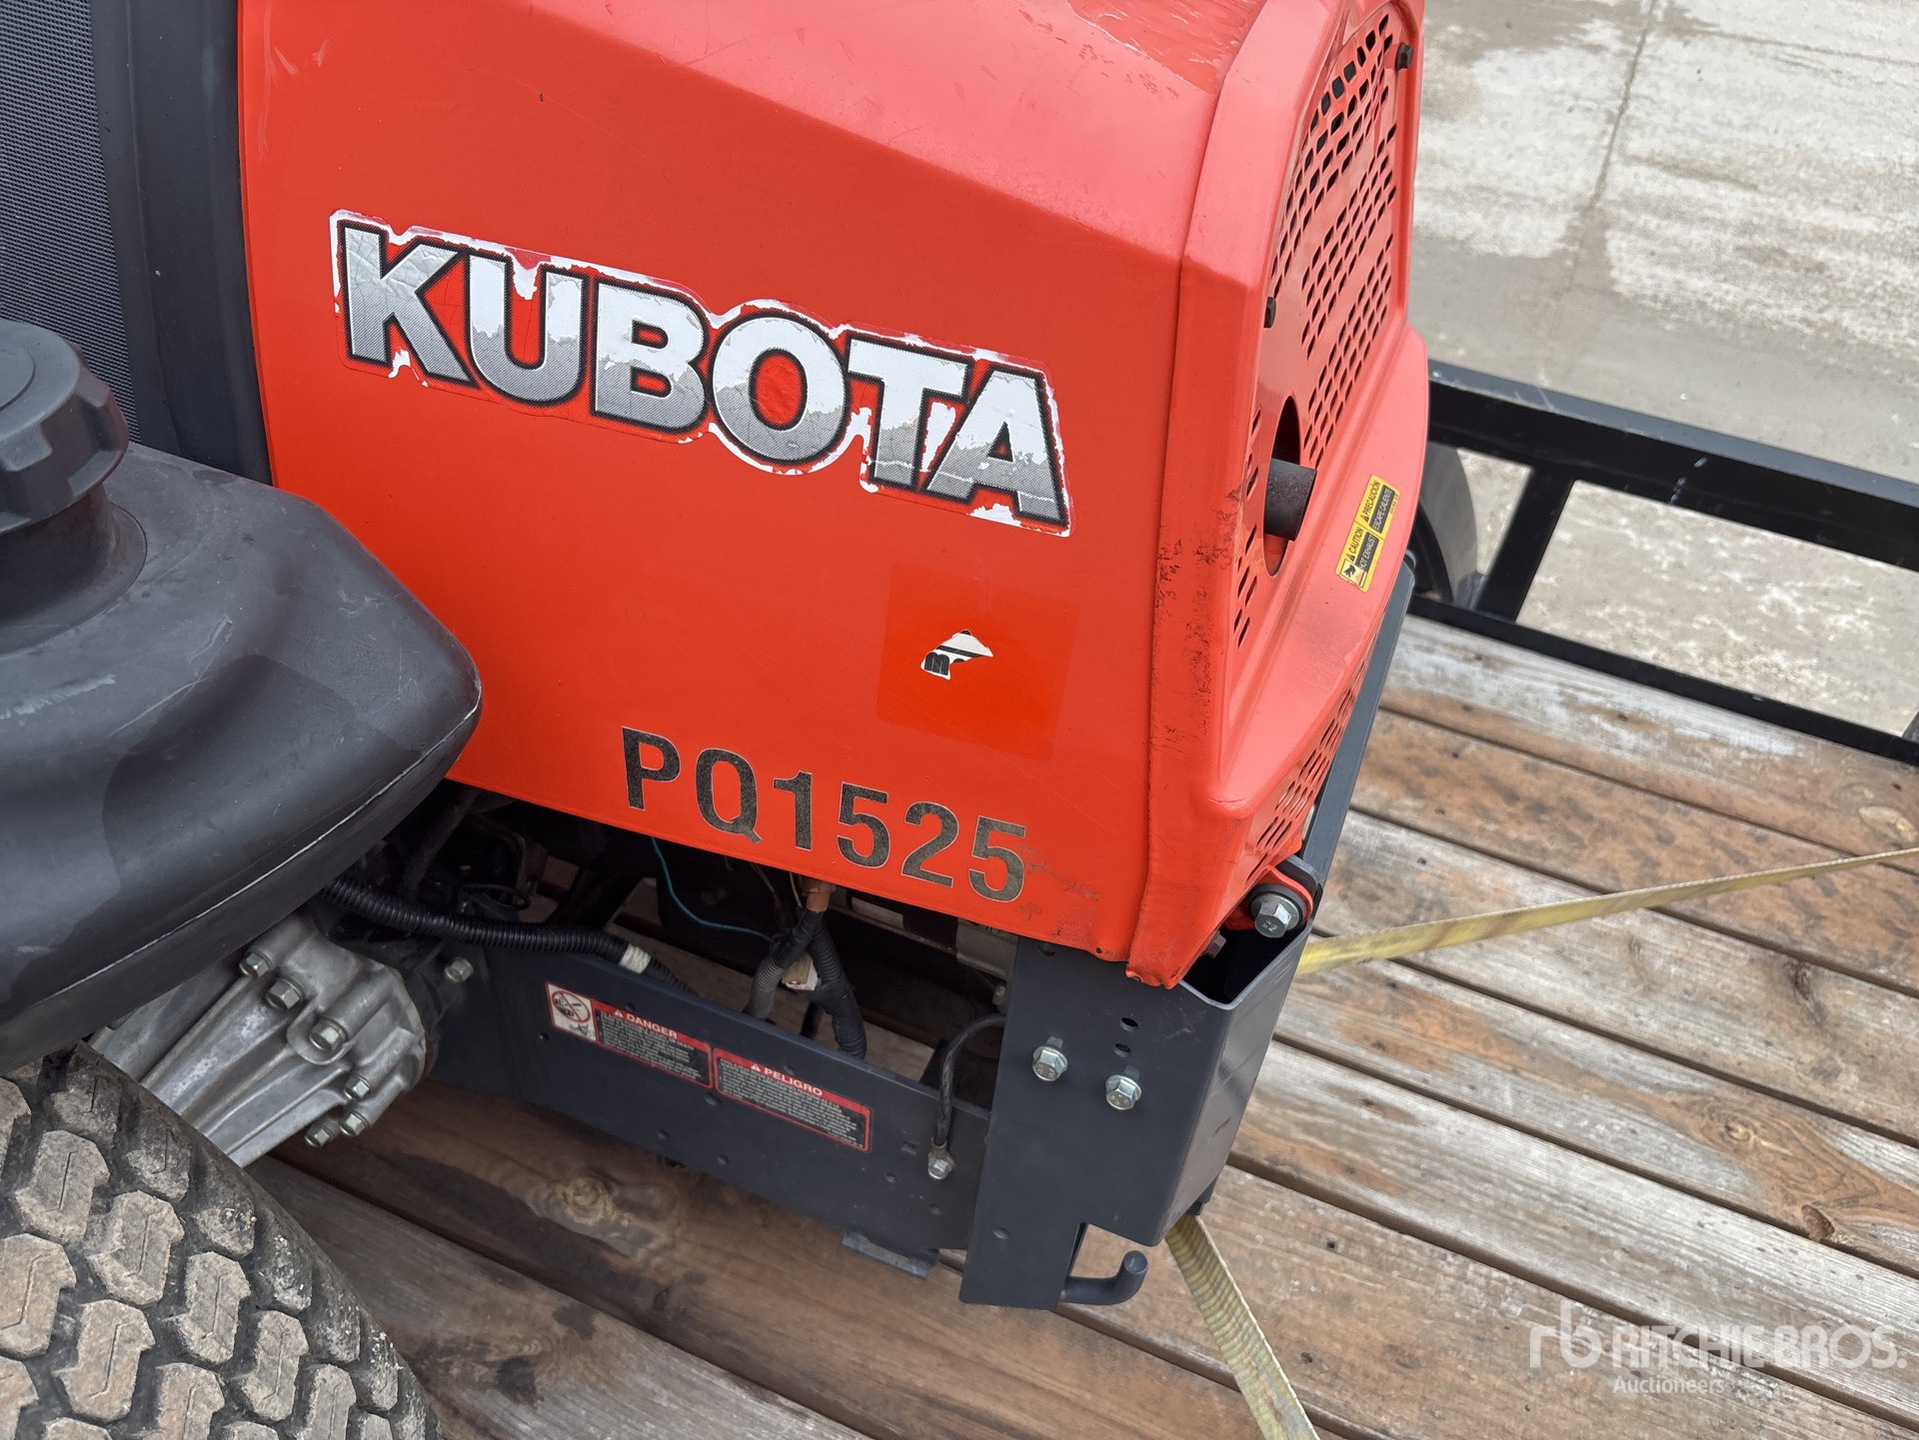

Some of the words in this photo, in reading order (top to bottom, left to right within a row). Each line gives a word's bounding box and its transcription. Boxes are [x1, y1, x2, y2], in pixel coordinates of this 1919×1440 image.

[336, 216, 1070, 530] KUBOTA
[1348, 527, 1364, 555] CAUTION
[1363, 534, 1376, 560] EXHAUST
[622, 726, 1027, 902] PQ1525
[626, 1012, 678, 1040] DANGER
[764, 1068, 823, 1097] PELIGRO
